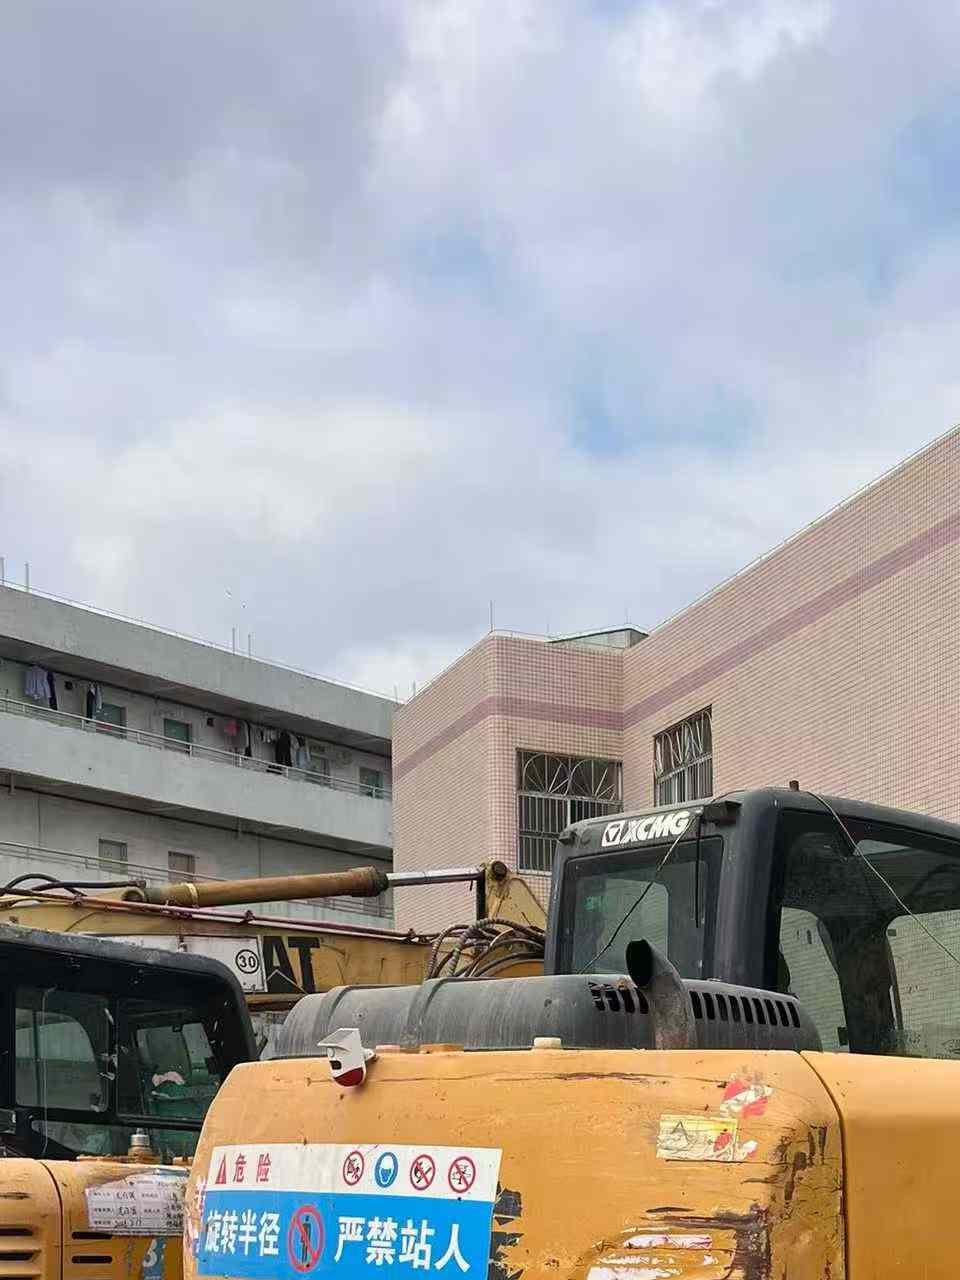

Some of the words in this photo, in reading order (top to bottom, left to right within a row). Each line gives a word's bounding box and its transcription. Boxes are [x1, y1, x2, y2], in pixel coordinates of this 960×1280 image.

[619, 811, 691, 844] XCMG
[239, 955, 257, 969] 30
[232, 1153, 272, 1183] 危险
[204, 1208, 281, 1257] 旋转半径
[334, 1216, 471, 1273] 严禁站人
